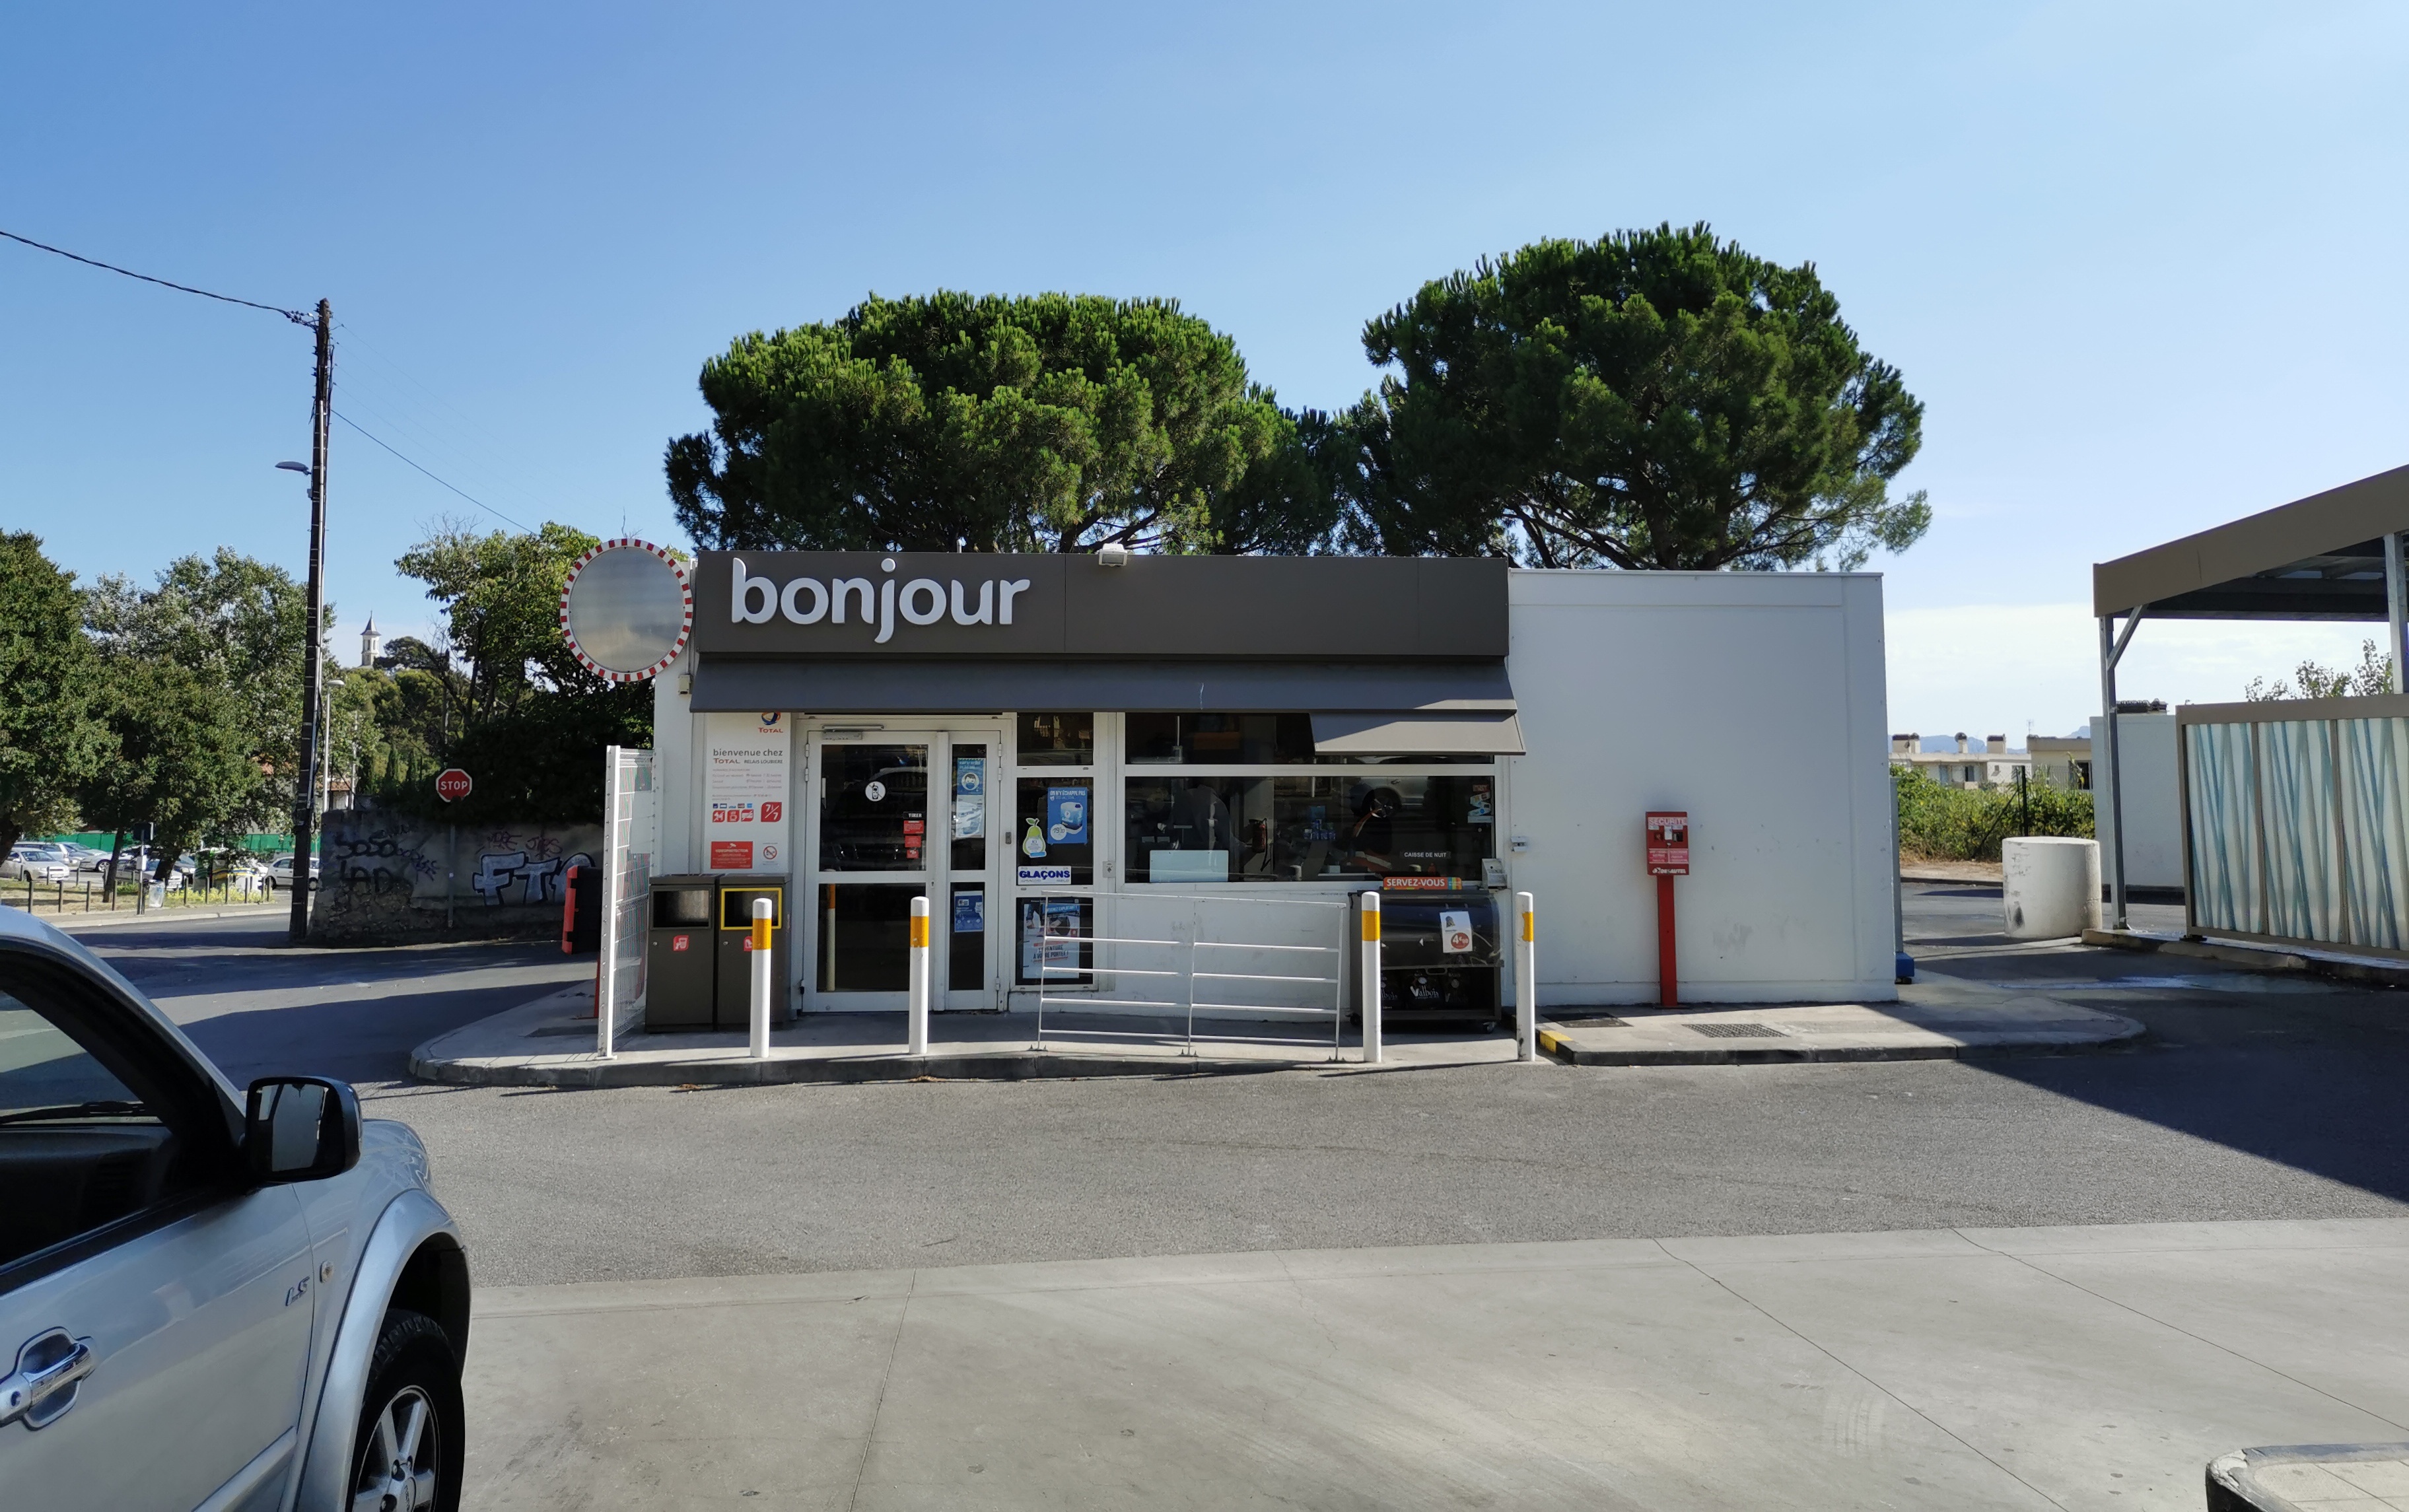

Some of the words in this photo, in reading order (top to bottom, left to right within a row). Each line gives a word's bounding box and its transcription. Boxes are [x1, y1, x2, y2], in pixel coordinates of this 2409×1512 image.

[731, 557, 1031, 644] bonjour
[440, 780, 468, 791] STOP
[1019, 870, 1070, 880] GLAÇONS
[1386, 878, 1446, 887] SERVEZ-VOUS
[1409, 984, 1439, 997] Valbois
